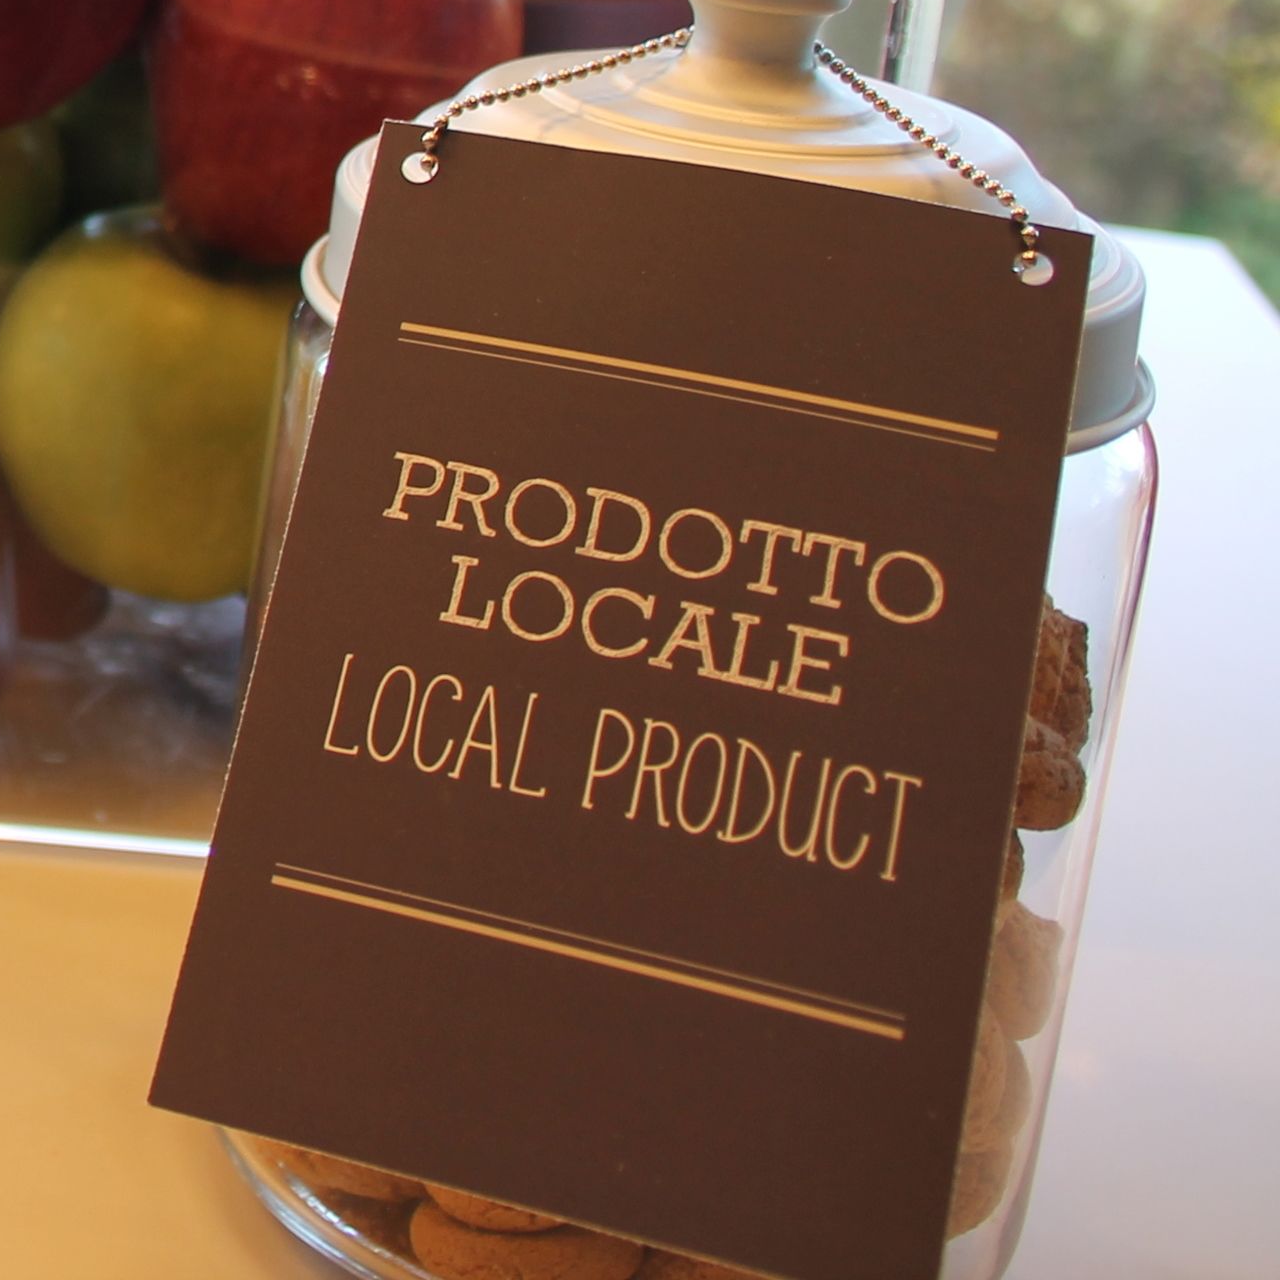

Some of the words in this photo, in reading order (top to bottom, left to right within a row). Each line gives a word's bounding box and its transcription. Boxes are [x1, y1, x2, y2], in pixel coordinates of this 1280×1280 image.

[382, 451, 945, 624] PRODOTTO
[439, 554, 850, 705] LOCALE
[322, 652, 547, 797] LOCAL
[581, 707, 922, 881] PRODUCT
